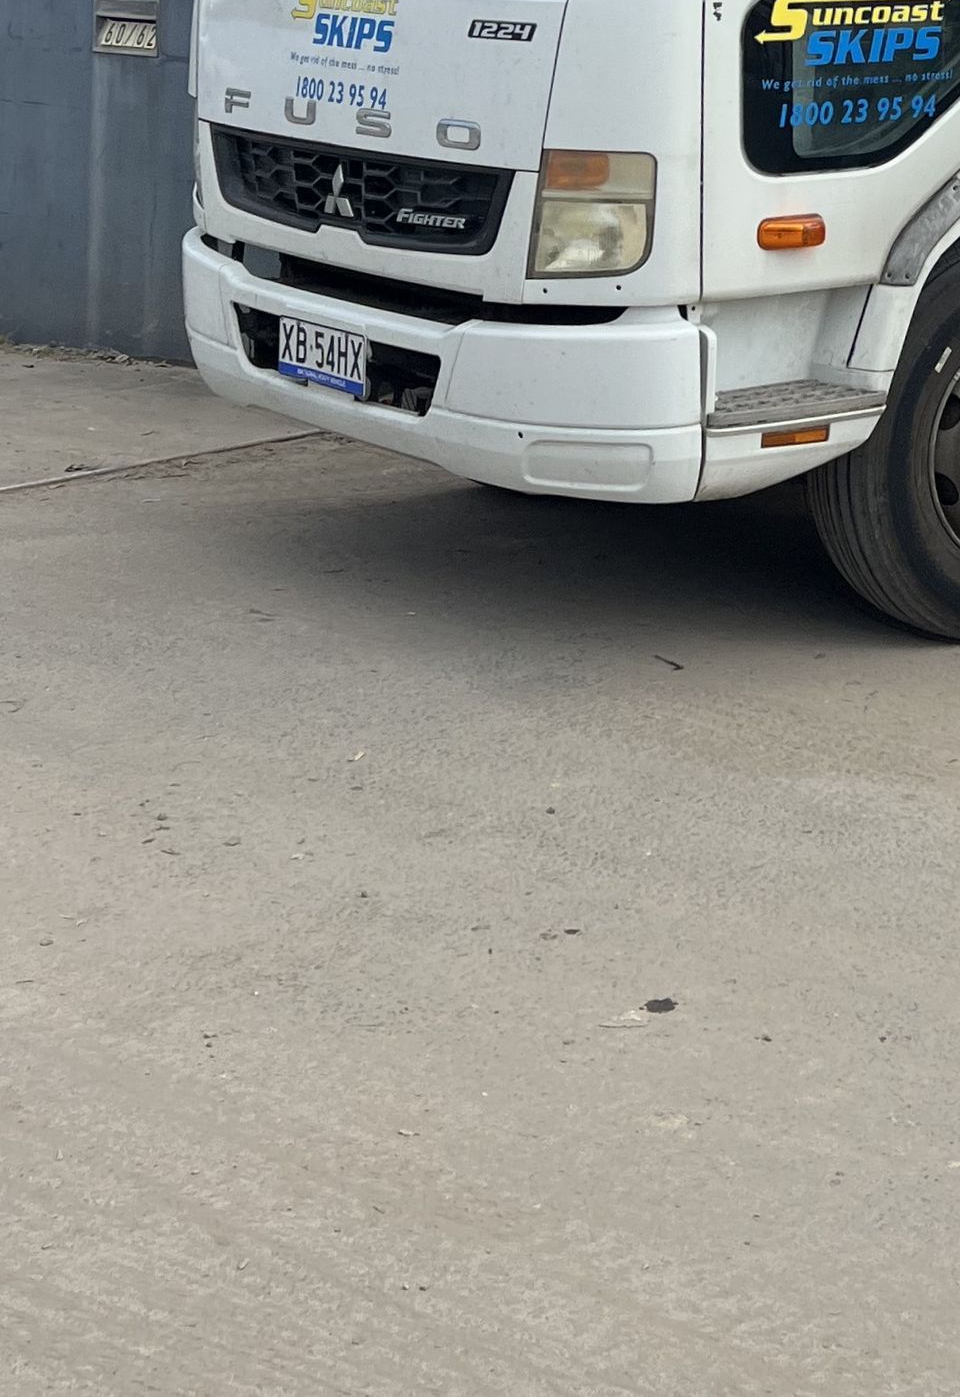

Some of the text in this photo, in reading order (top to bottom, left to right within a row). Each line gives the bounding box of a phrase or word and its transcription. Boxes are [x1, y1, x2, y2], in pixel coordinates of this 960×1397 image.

[104, 22, 157, 47] 60/62
[312, 13, 395, 53] SKIPS
[471, 20, 532, 40] 1224
[804, 26, 942, 66] SKIPS
[321, 56, 329, 67] of
[367, 64, 376, 72] no
[296, 76, 387, 110] 1800 23 95 94
[761, 79, 780, 91] We
[826, 75, 840, 89] of
[841, 75, 860, 86] the
[863, 75, 889, 85] mess
[905, 73, 919, 83] no
[224, 87, 482, 151] FUSO
[779, 94, 937, 128] 1800 23 95 94
